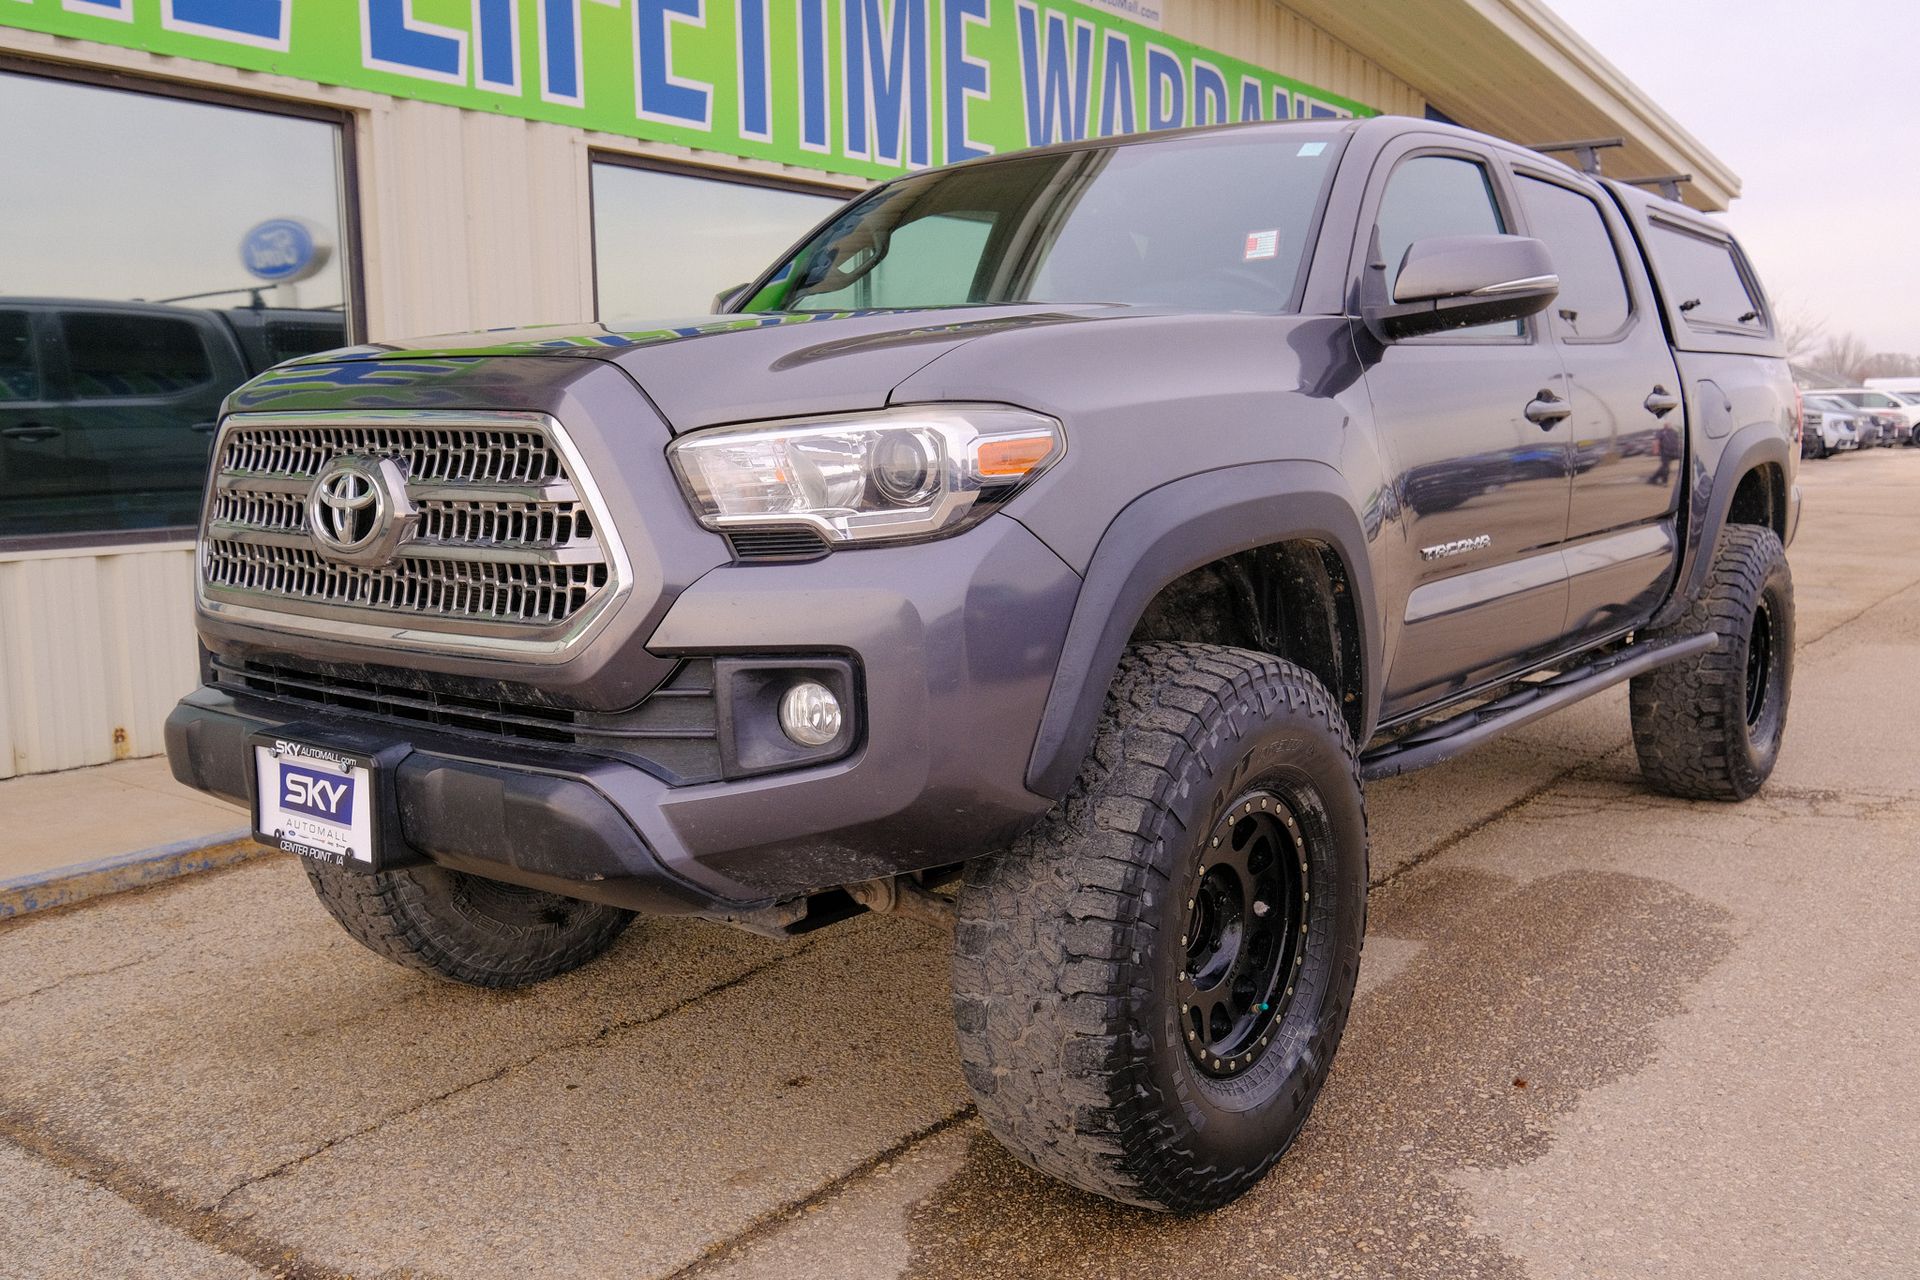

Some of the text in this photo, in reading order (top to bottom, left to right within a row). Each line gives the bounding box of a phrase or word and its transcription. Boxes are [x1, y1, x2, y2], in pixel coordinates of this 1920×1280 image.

[1014, 0, 1367, 147] WARR
[1420, 534, 1491, 560] TACOMA
[285, 772, 348, 814] SKY
[286, 818, 347, 842] AUTOMALL
[280, 840, 308, 857] CENTER
[308, 847, 333, 864] POINT,
[335, 855, 344, 867] IA
